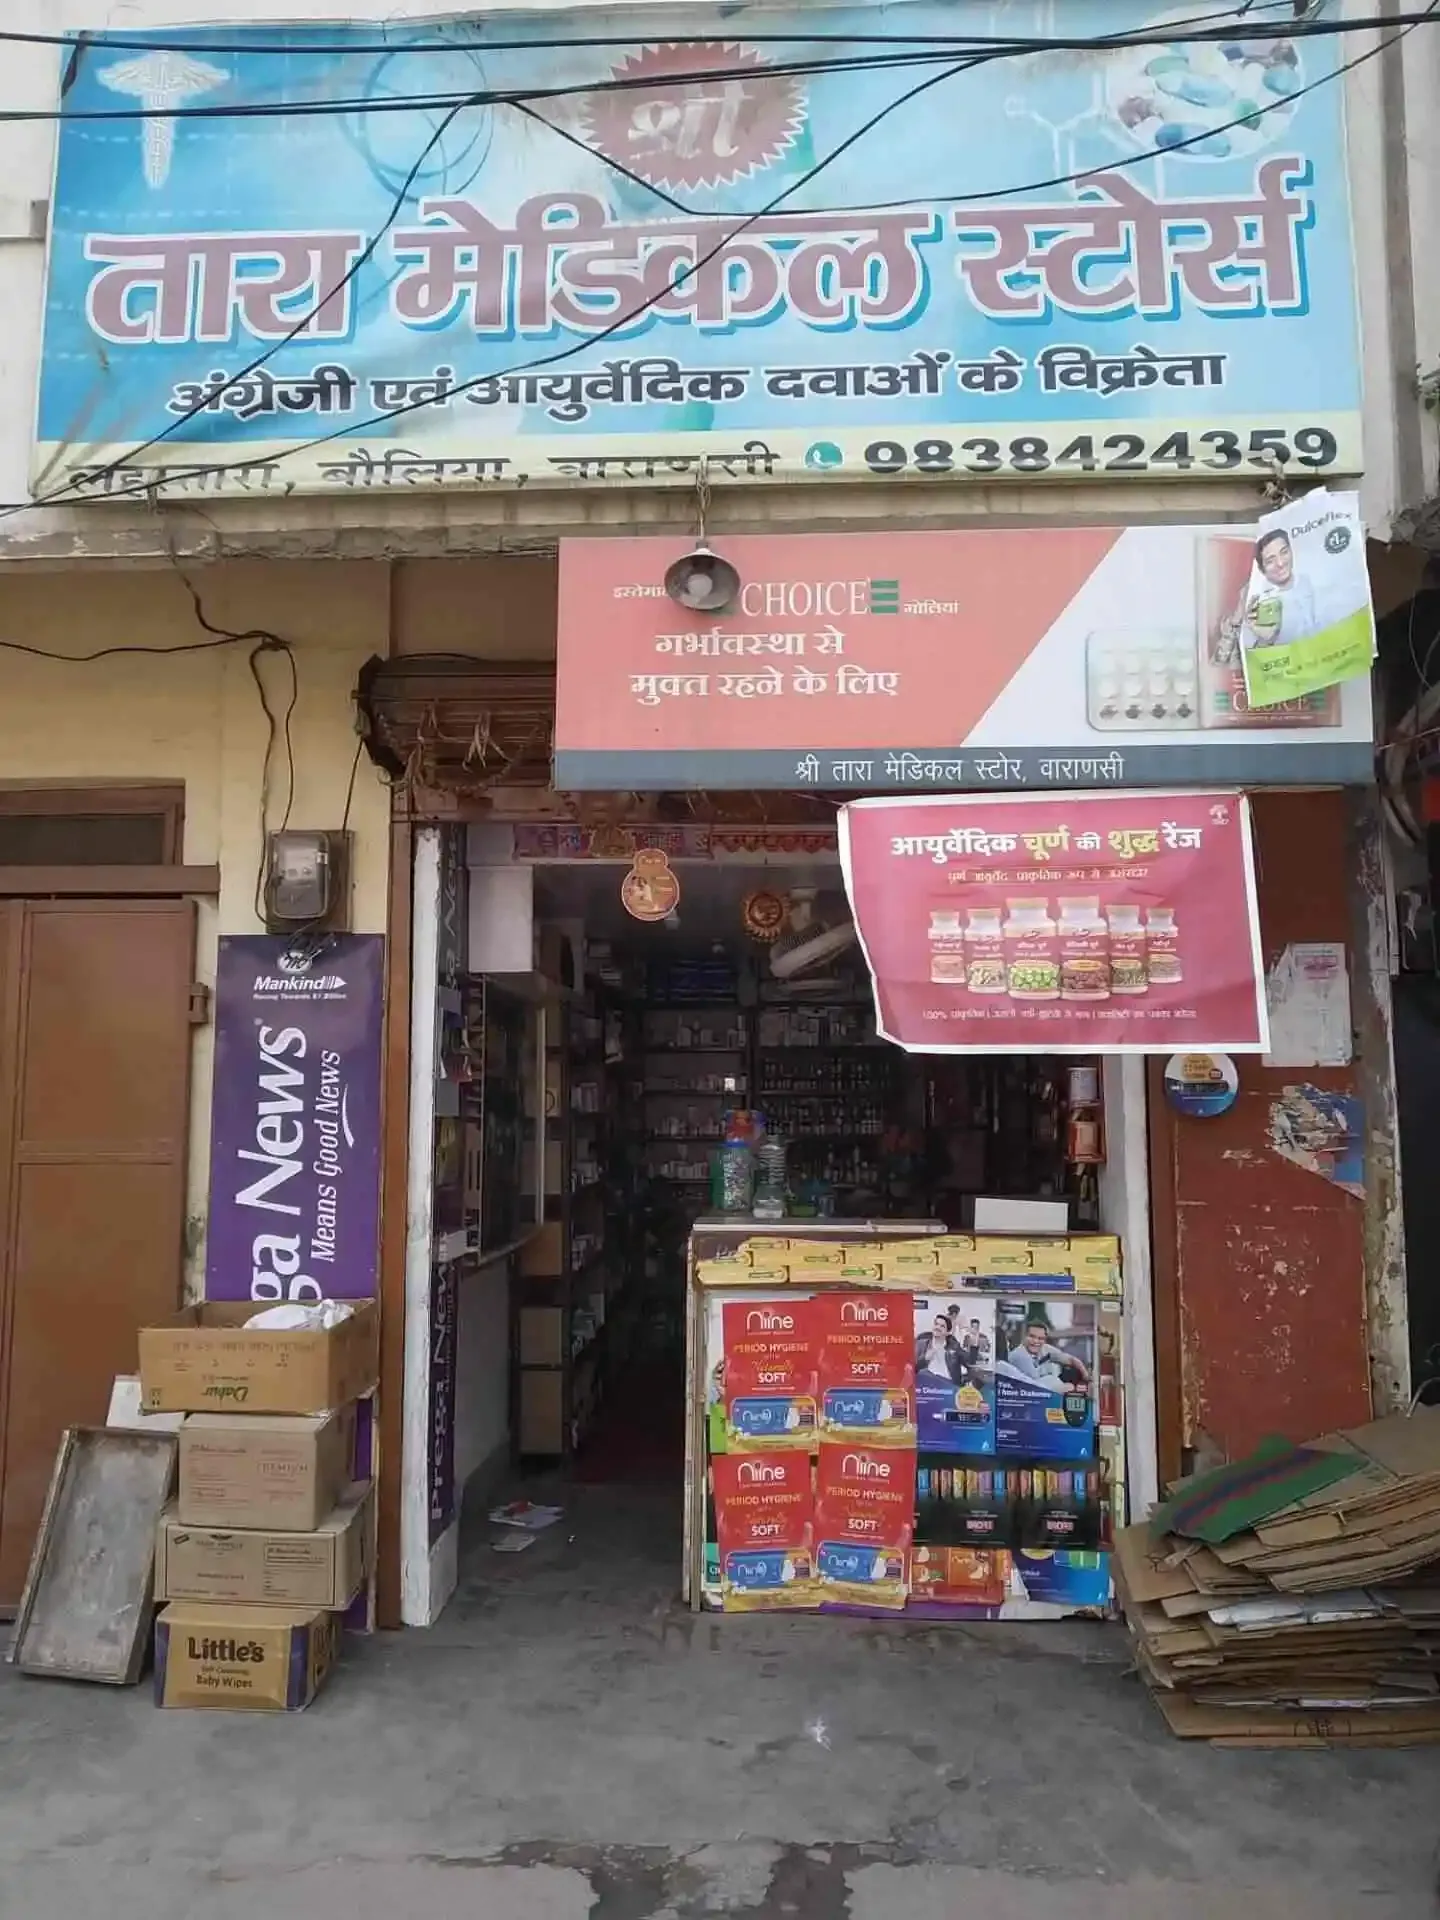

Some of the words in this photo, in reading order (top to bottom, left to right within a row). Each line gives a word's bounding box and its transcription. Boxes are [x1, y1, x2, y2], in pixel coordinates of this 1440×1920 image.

[84, 232, 364, 342] तारा
[394, 194, 930, 322] मेडिकल
[955, 158, 1306, 316] स्टोर्स
[168, 365, 355, 418] अंग्रेजी
[370, 367, 453, 411] एवं
[467, 359, 749, 422] आयुर्वेदिक
[766, 351, 949, 398] दवाओं
[958, 348, 1022, 394] के
[1041, 347, 1226, 398] विक्रेता
[864, 427, 1338, 473] 9838424359
[742, 579, 868, 616] CHOICE
[655, 626, 806, 656] गर्भावस्था
[812, 625, 846, 656] से
[630, 673, 710, 705] मुक्त
[718, 666, 784, 698] रहने
[792, 665, 828, 696] के
[836, 664, 901, 696] लिए
[795, 753, 819, 783] श्री
[831, 759, 873, 782] तारा
[884, 752, 963, 782] मेडिकल
[974, 752, 1027, 784] स्टोर,
[1039, 751, 1125, 781] वाराणसी
[891, 827, 1017, 863] आयुर्वेदिक
[1021, 825, 1069, 860] चूर्ण
[1075, 832, 1102, 851] की
[1107, 828, 1160, 859] शुद्ध
[1163, 821, 1202, 849] रेंज
[253, 975, 326, 990] Mankind
[321, 1050, 341, 1113] News
[236, 1024, 307, 1215] News
[313, 1116, 339, 1176] Good
[310, 1184, 337, 1263] Means
[758, 1372, 786, 1384] SOFT
[851, 1363, 880, 1374] SOFT
[200, 1386, 249, 1401] Dabur
[752, 1524, 780, 1537] SOFT
[848, 1518, 877, 1531] SOFT
[188, 1636, 265, 1662] Little's
[196, 1674, 220, 1688] Baby
[222, 1677, 252, 1688] Wipes
